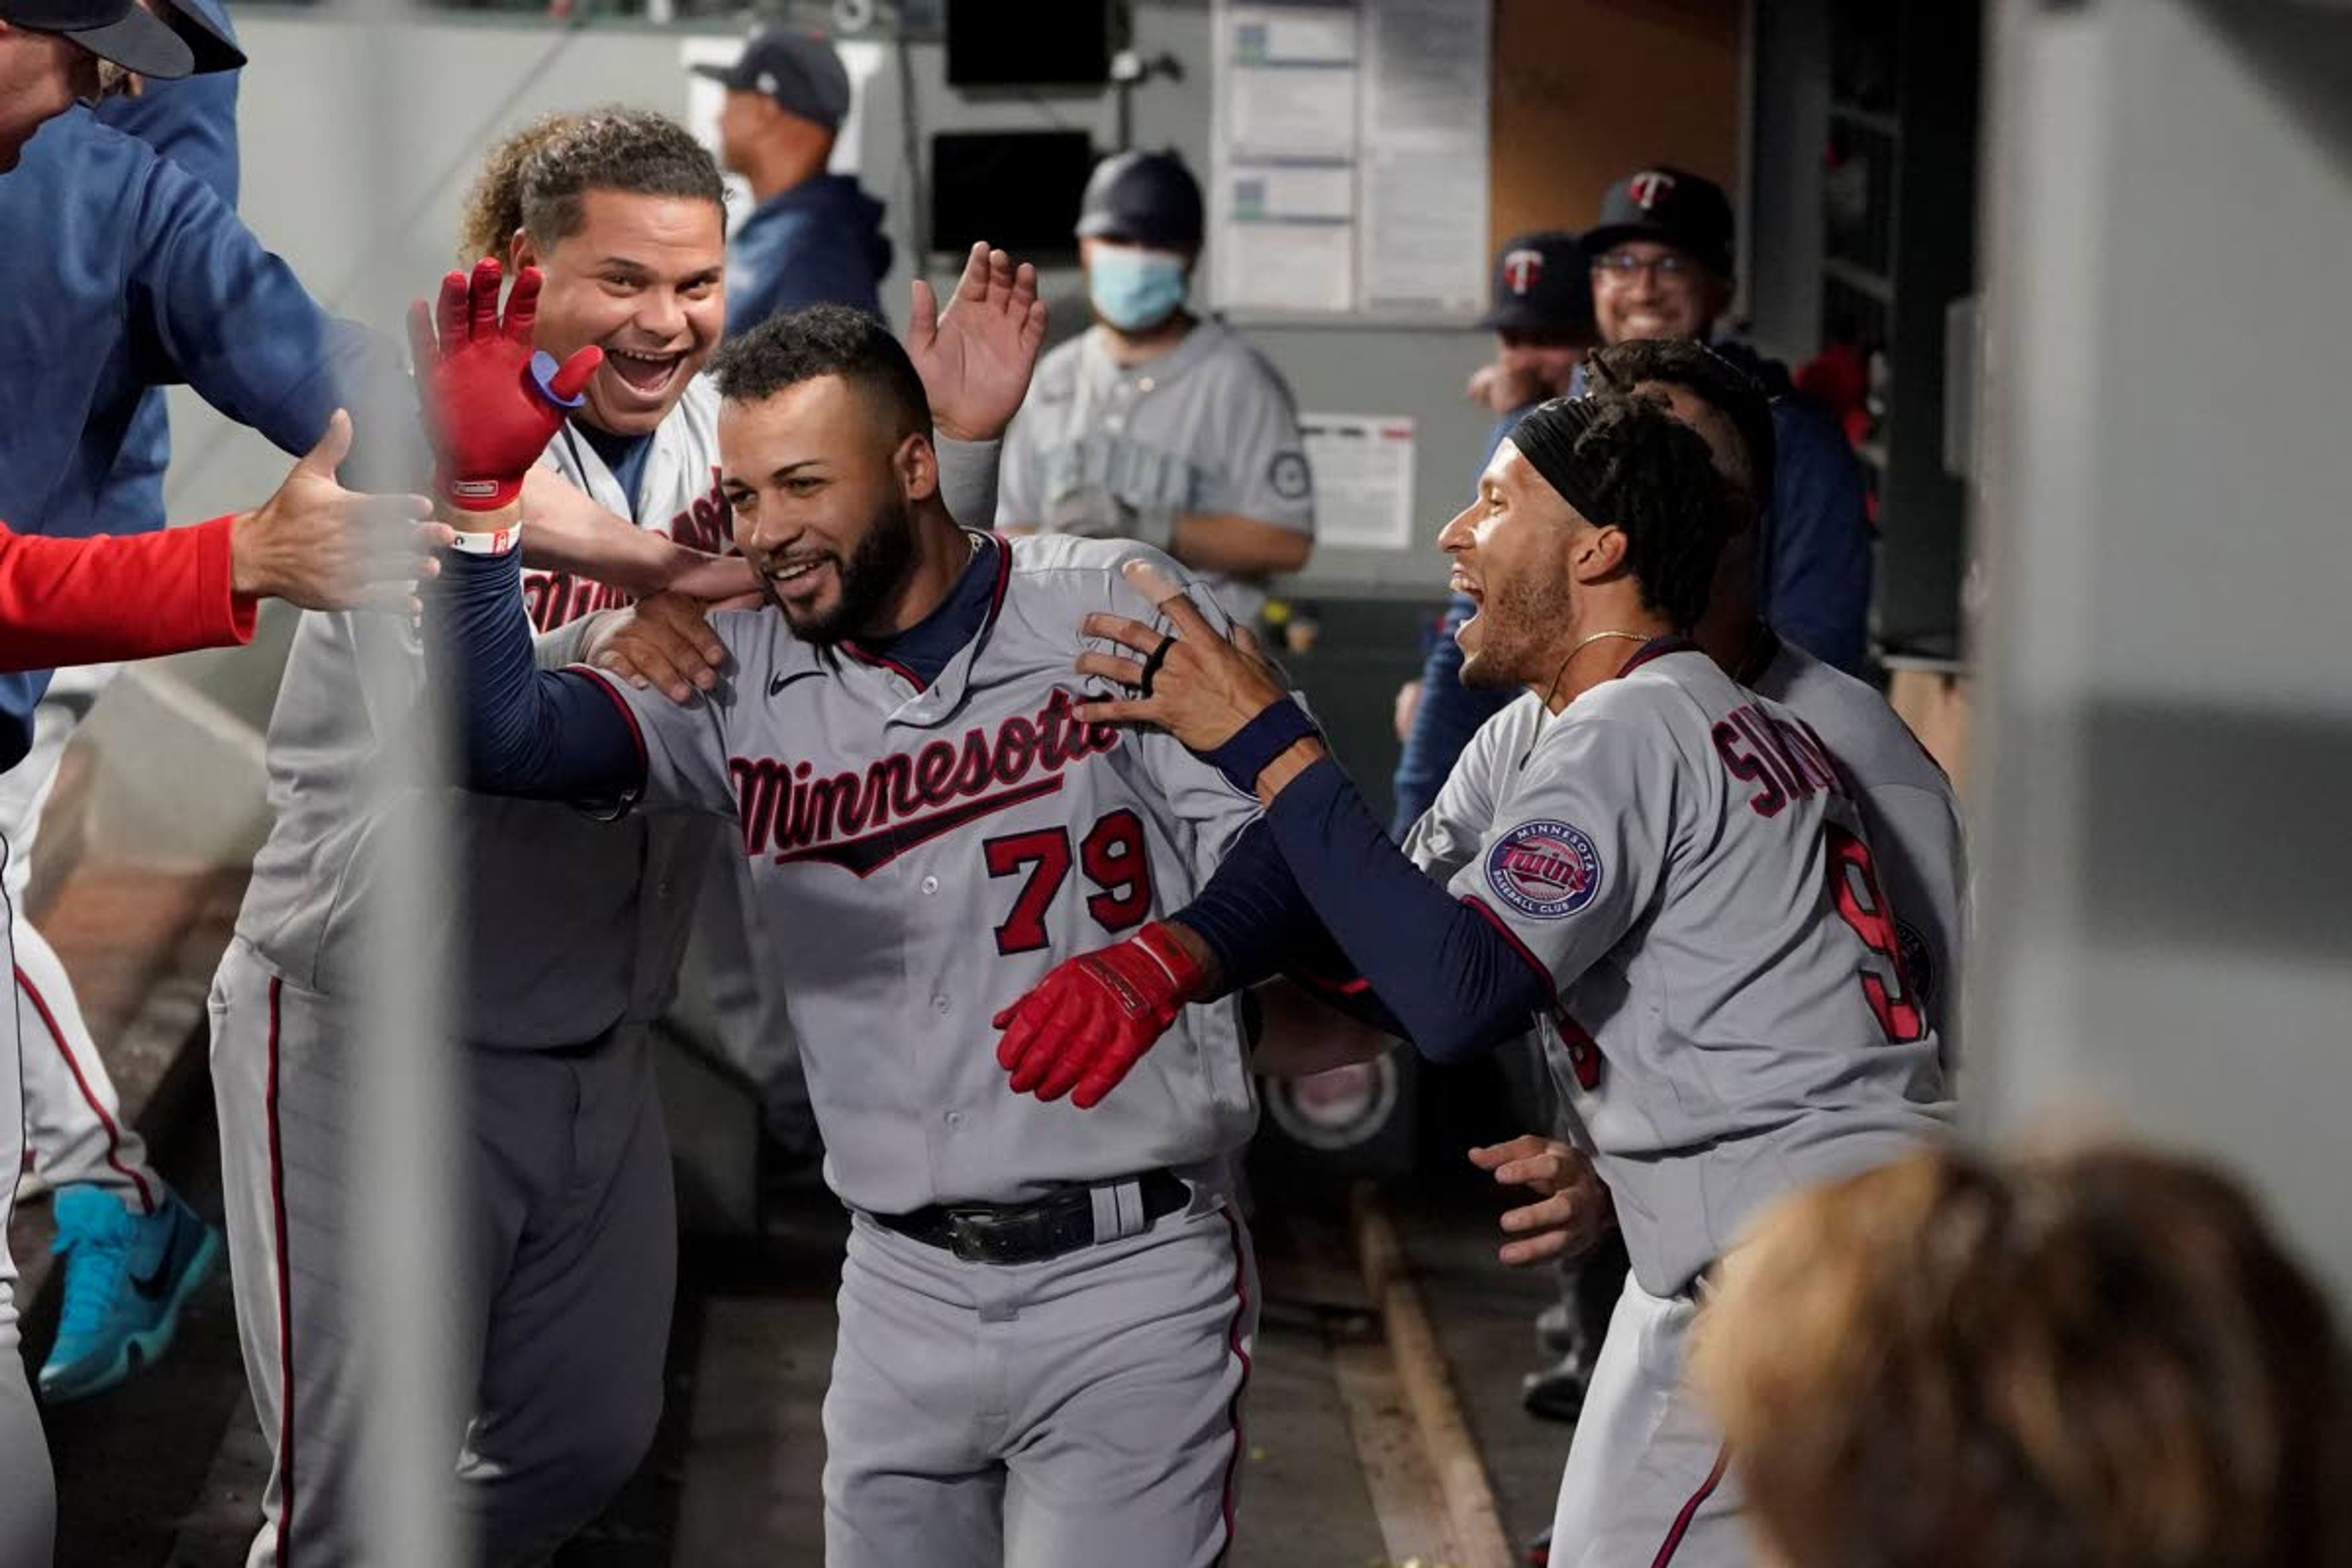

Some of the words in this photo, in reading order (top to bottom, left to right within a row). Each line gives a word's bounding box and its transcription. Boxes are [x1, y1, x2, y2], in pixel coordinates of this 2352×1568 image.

[729, 688, 1120, 856] Minnesota
[1501, 841, 1587, 893] Twins
[1517, 824, 1595, 872] MINNESOTA
[982, 807, 1153, 956] 79
[1493, 870, 1534, 910] BASEBALL
[1539, 902, 1570, 913] CLUB
